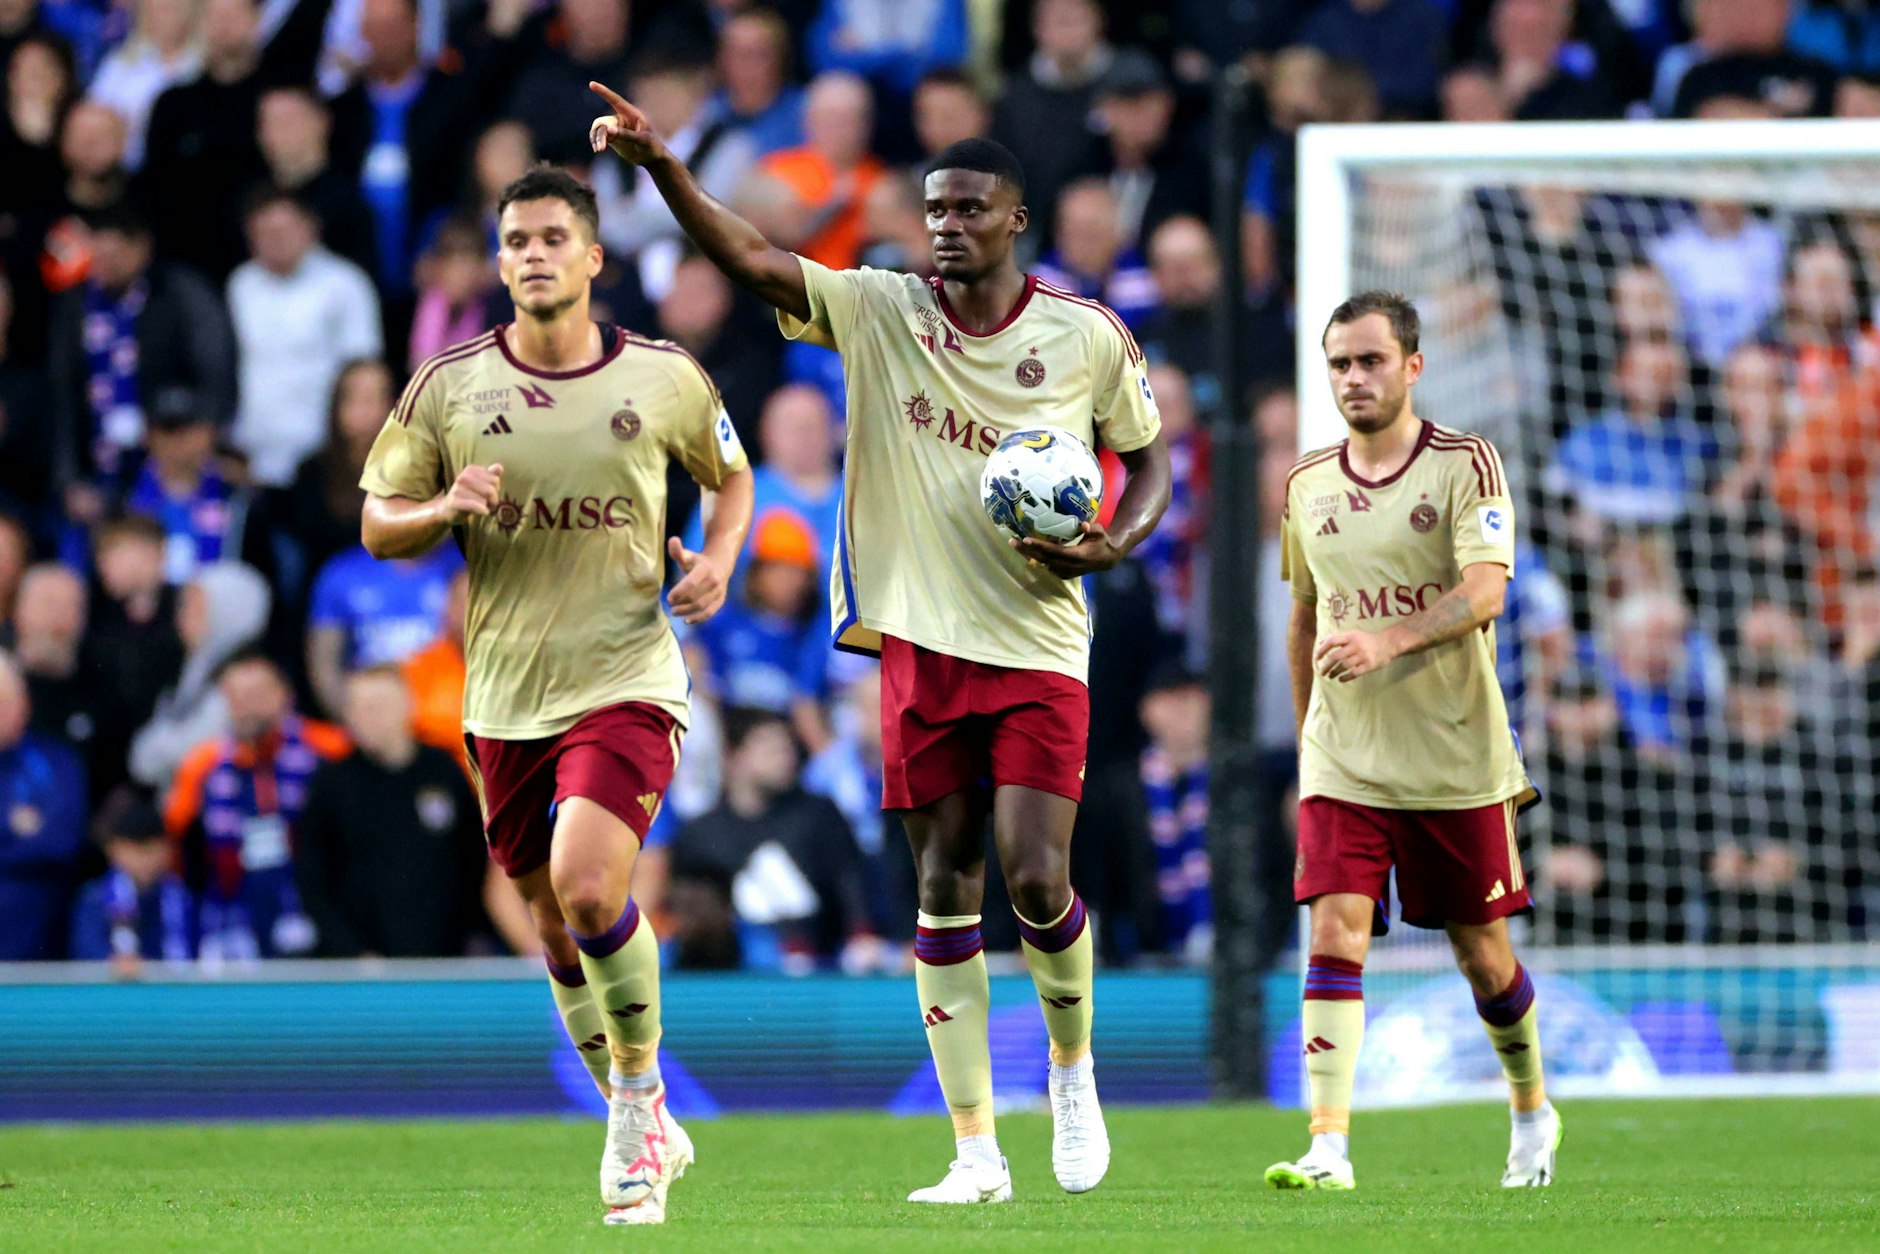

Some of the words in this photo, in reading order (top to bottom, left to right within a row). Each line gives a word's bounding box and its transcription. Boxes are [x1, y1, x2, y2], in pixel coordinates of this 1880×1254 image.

[466, 388, 511, 402] CREDIT
[472, 401, 512, 414] SUISSE
[936, 407, 1001, 457] MS
[533, 496, 633, 530] MSC
